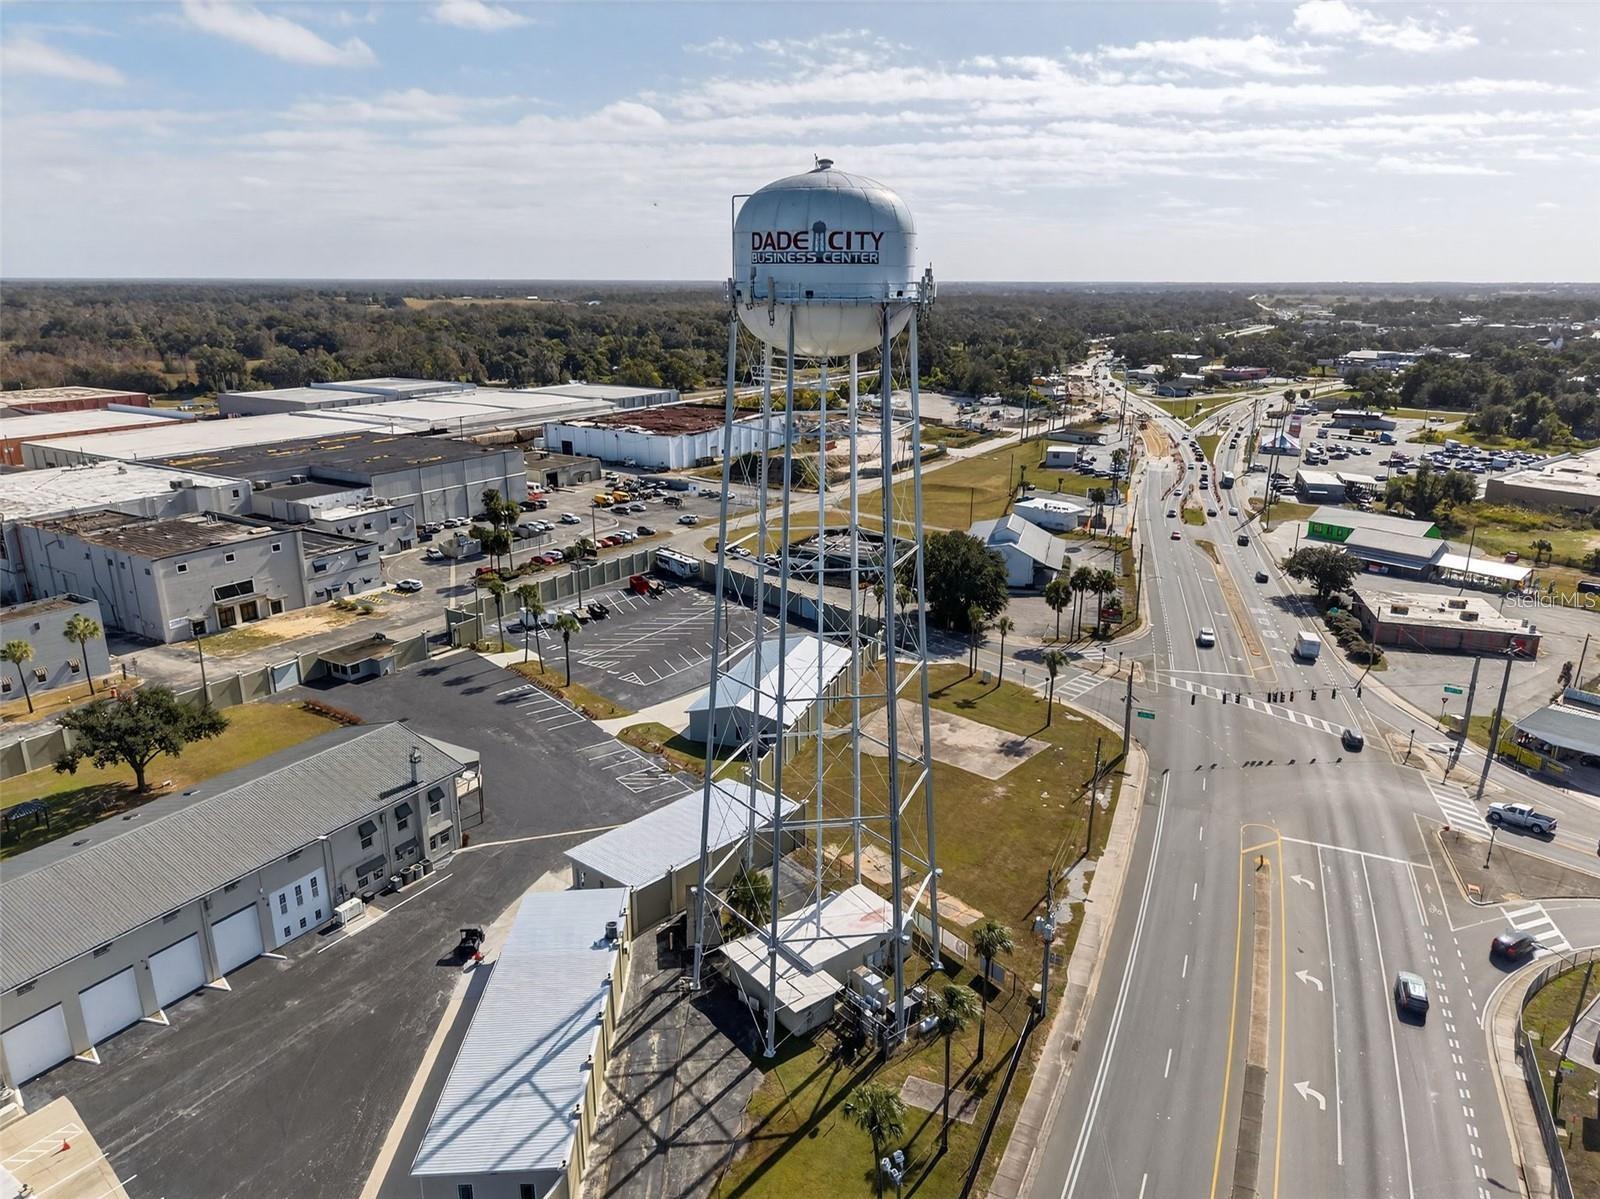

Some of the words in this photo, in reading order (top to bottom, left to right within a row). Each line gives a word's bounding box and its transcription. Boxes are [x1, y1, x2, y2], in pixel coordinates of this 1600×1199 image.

[752, 231, 809, 250] DADE
[828, 231, 885, 250] CITY
[752, 252, 816, 264] BUSINESS
[823, 252, 879, 264] CENTER
